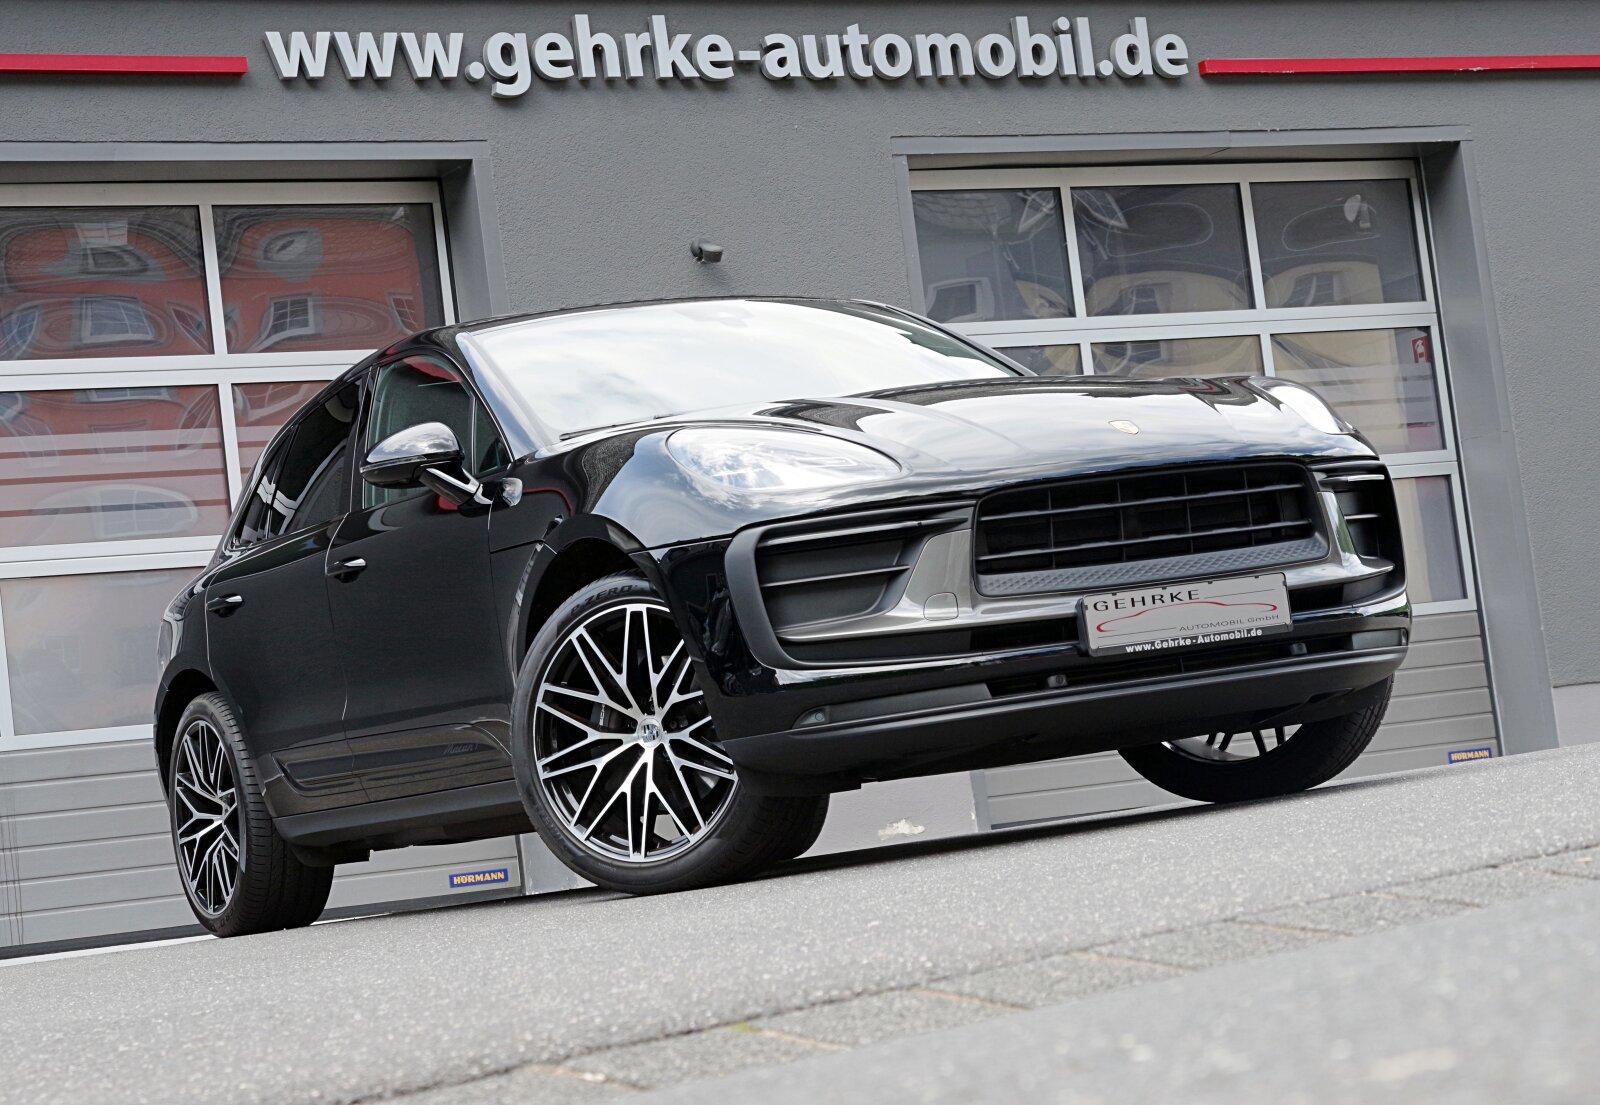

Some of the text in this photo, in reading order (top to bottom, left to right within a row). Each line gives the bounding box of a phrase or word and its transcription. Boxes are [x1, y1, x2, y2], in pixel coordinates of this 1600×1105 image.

[264, 13, 1189, 98] www.gehrke-automobil.de
[1093, 589, 1201, 612] GEHRKE
[1178, 614, 1280, 632] AUTOMOBIL GmbH
[1125, 628, 1263, 654] www.Gehrke-Automobil.de
